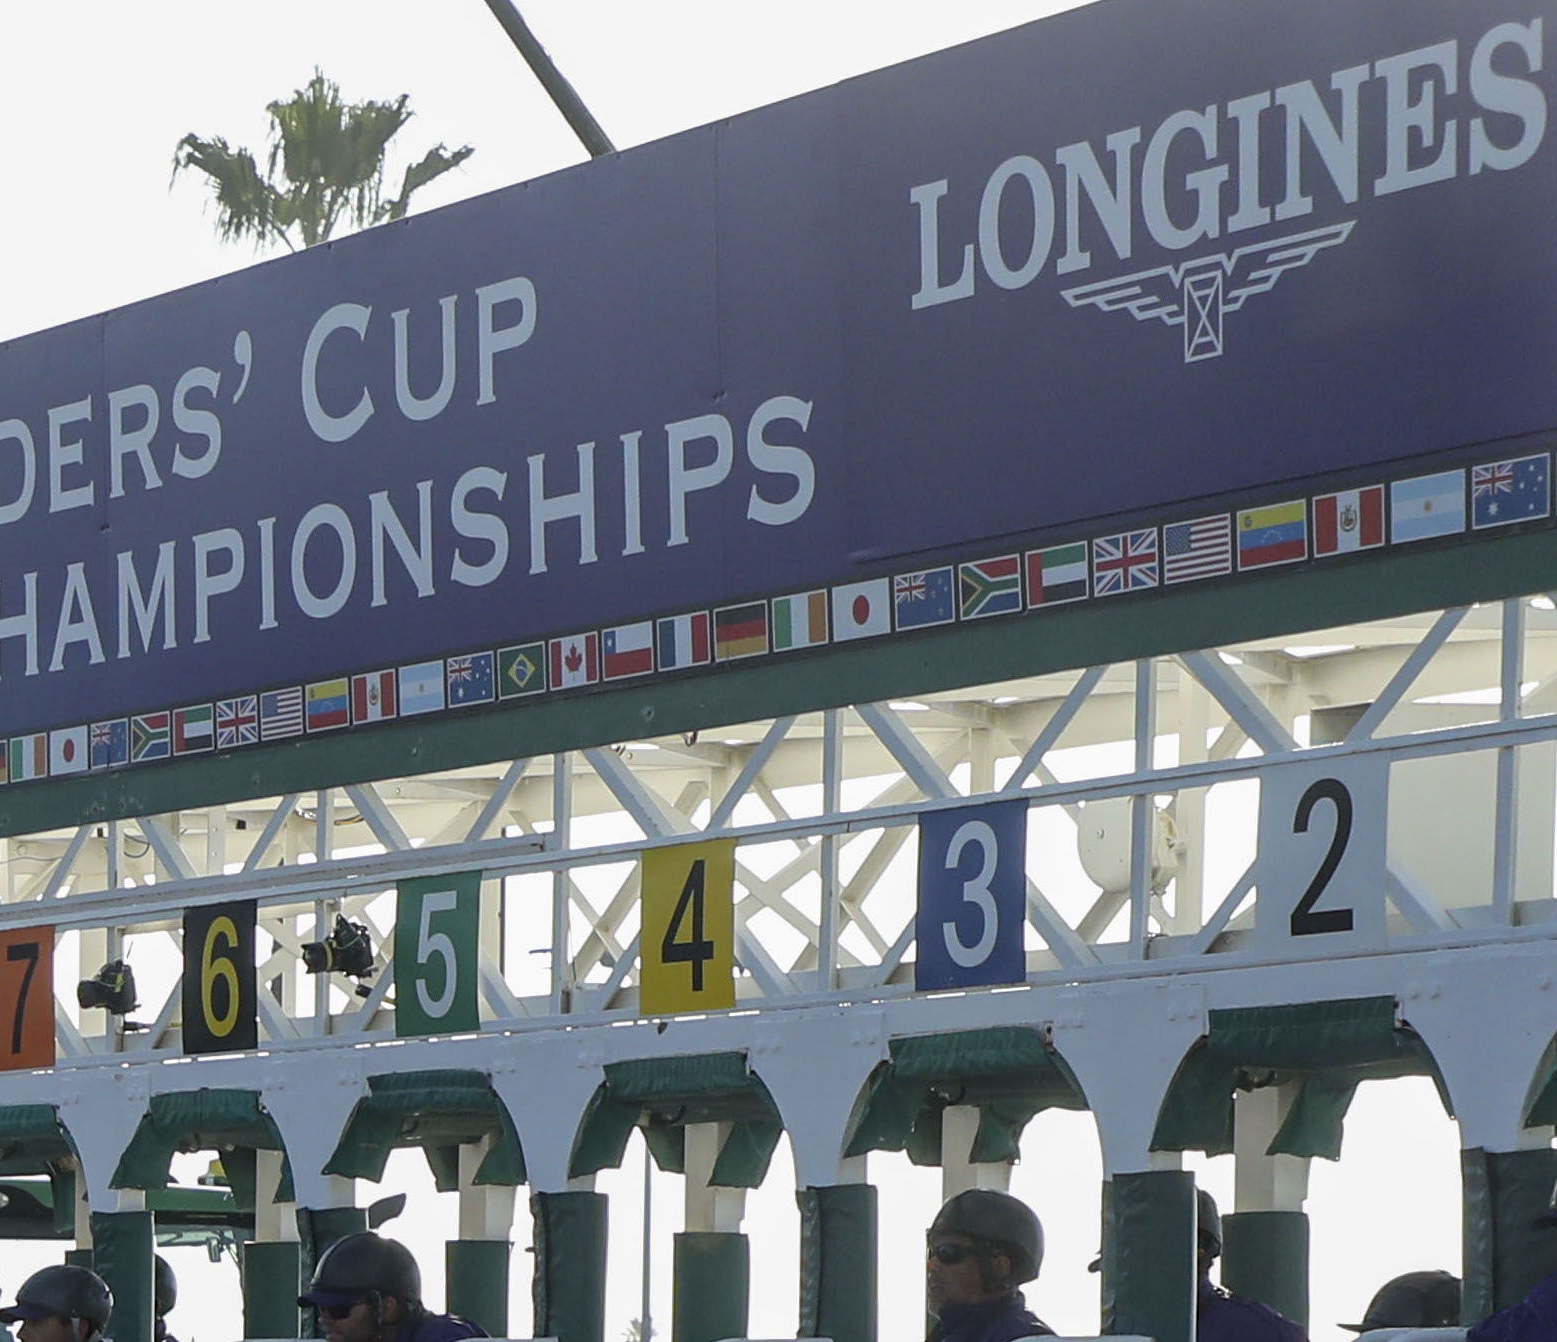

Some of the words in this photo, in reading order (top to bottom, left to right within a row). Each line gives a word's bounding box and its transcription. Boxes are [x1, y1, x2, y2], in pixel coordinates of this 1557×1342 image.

[910, 16, 1547, 310] LONGINES
[301, 276, 537, 442] CUP
[661, 858, 715, 993] 4
[942, 820, 999, 969] 3
[1289, 777, 1355, 939] 2
[6, 942, 40, 1054] 7
[201, 915, 238, 1038] 6
[415, 890, 459, 1019] 5
